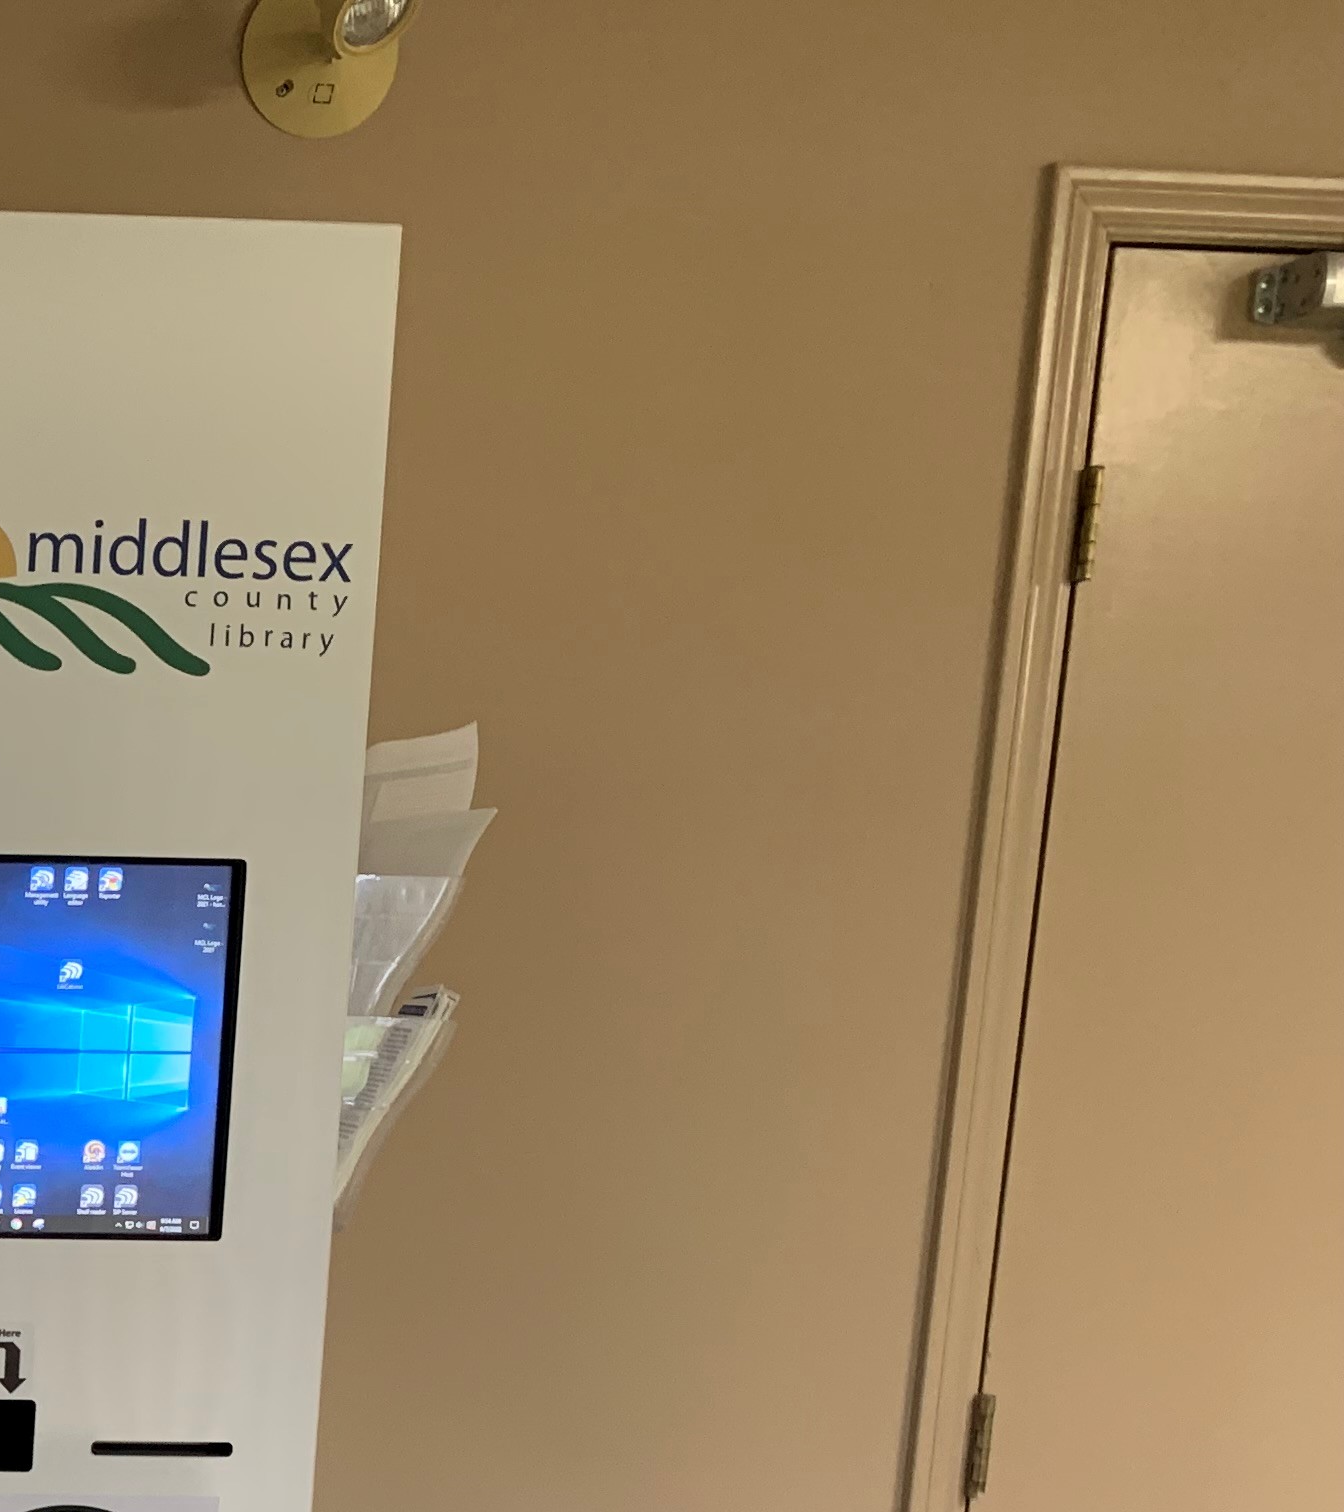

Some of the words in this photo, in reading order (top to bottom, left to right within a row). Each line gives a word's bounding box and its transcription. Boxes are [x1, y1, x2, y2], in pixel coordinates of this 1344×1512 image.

[28, 518, 353, 583] middlesex
[184, 589, 348, 616] county
[210, 623, 334, 656] library
[0, 1329, 21, 1337] Here
